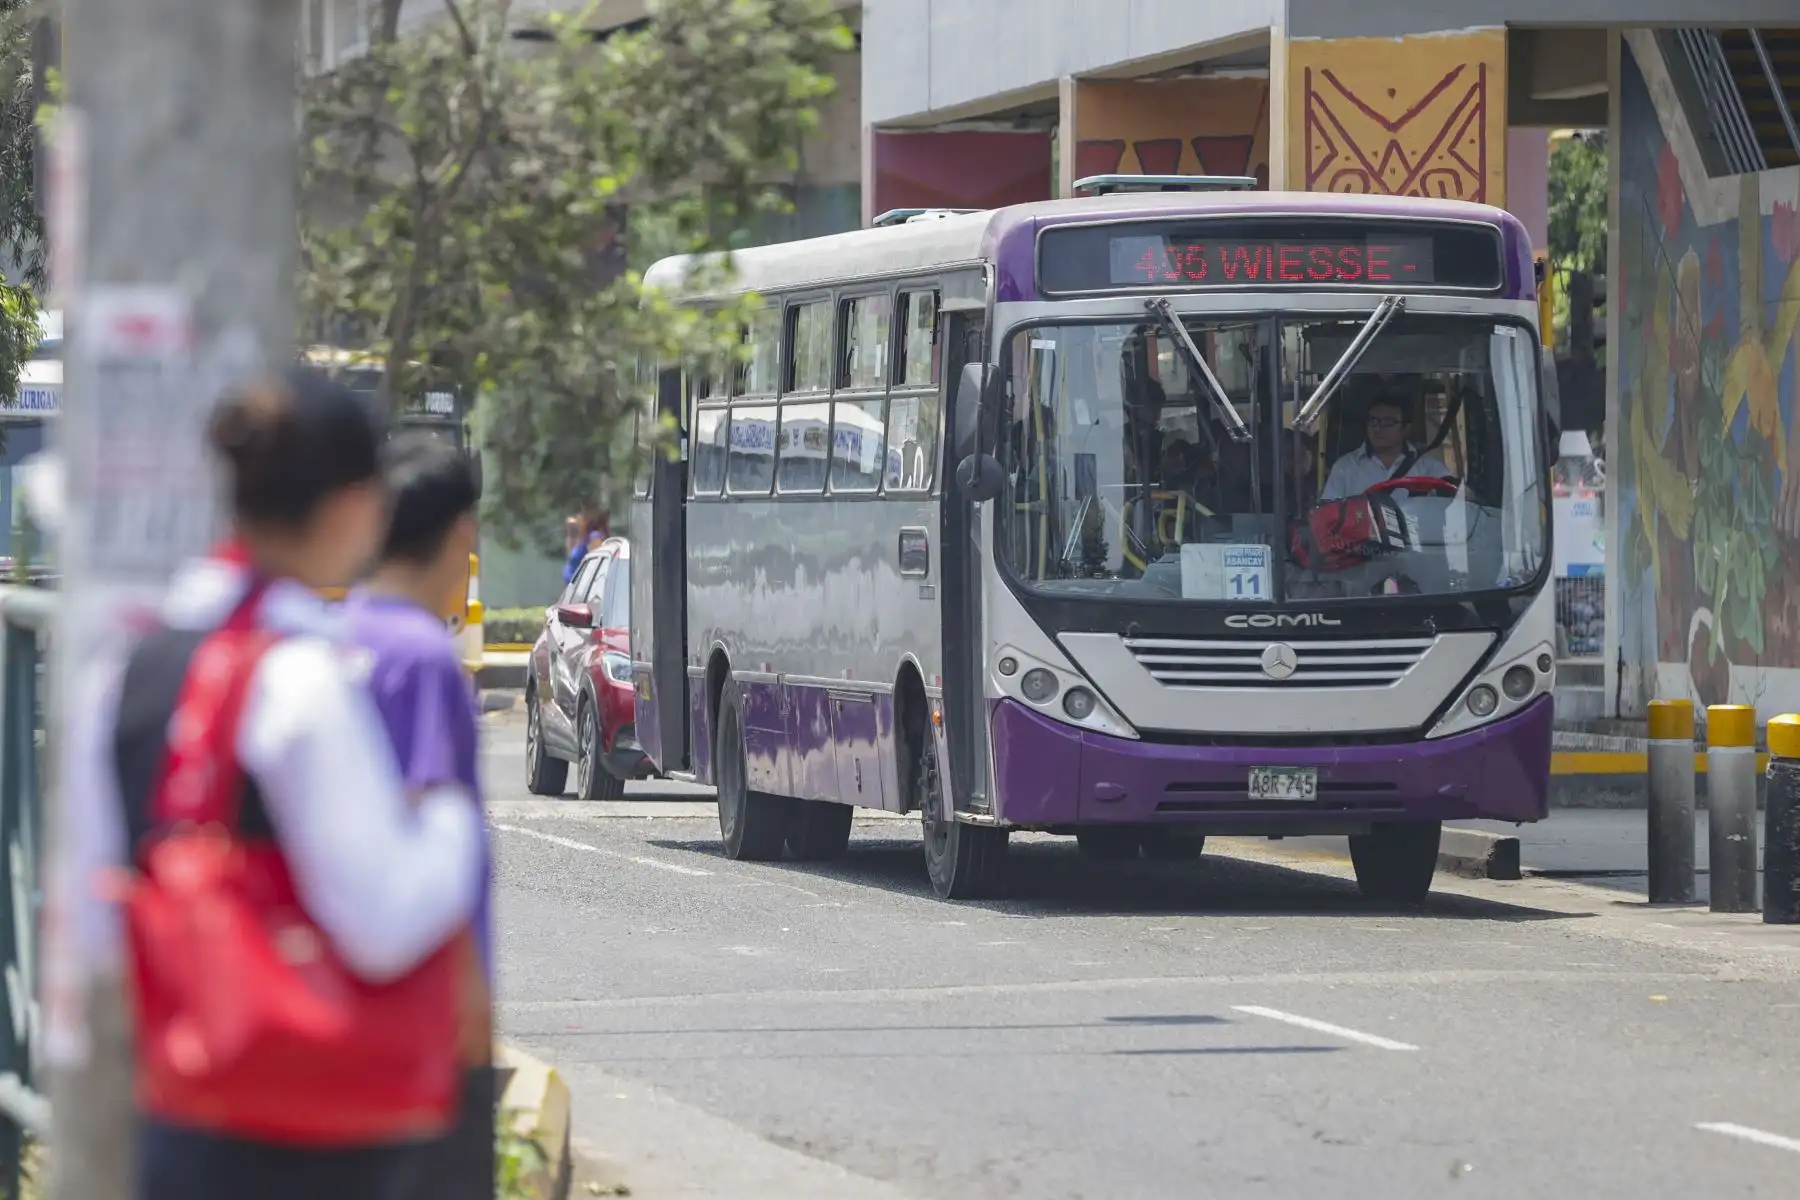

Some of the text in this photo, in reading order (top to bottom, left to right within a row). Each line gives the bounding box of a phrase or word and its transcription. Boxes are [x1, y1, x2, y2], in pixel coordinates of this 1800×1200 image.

[1220, 244, 1391, 280] WIESSE
[1230, 573, 1259, 595] 11
[1224, 614, 1341, 628] COMIL
